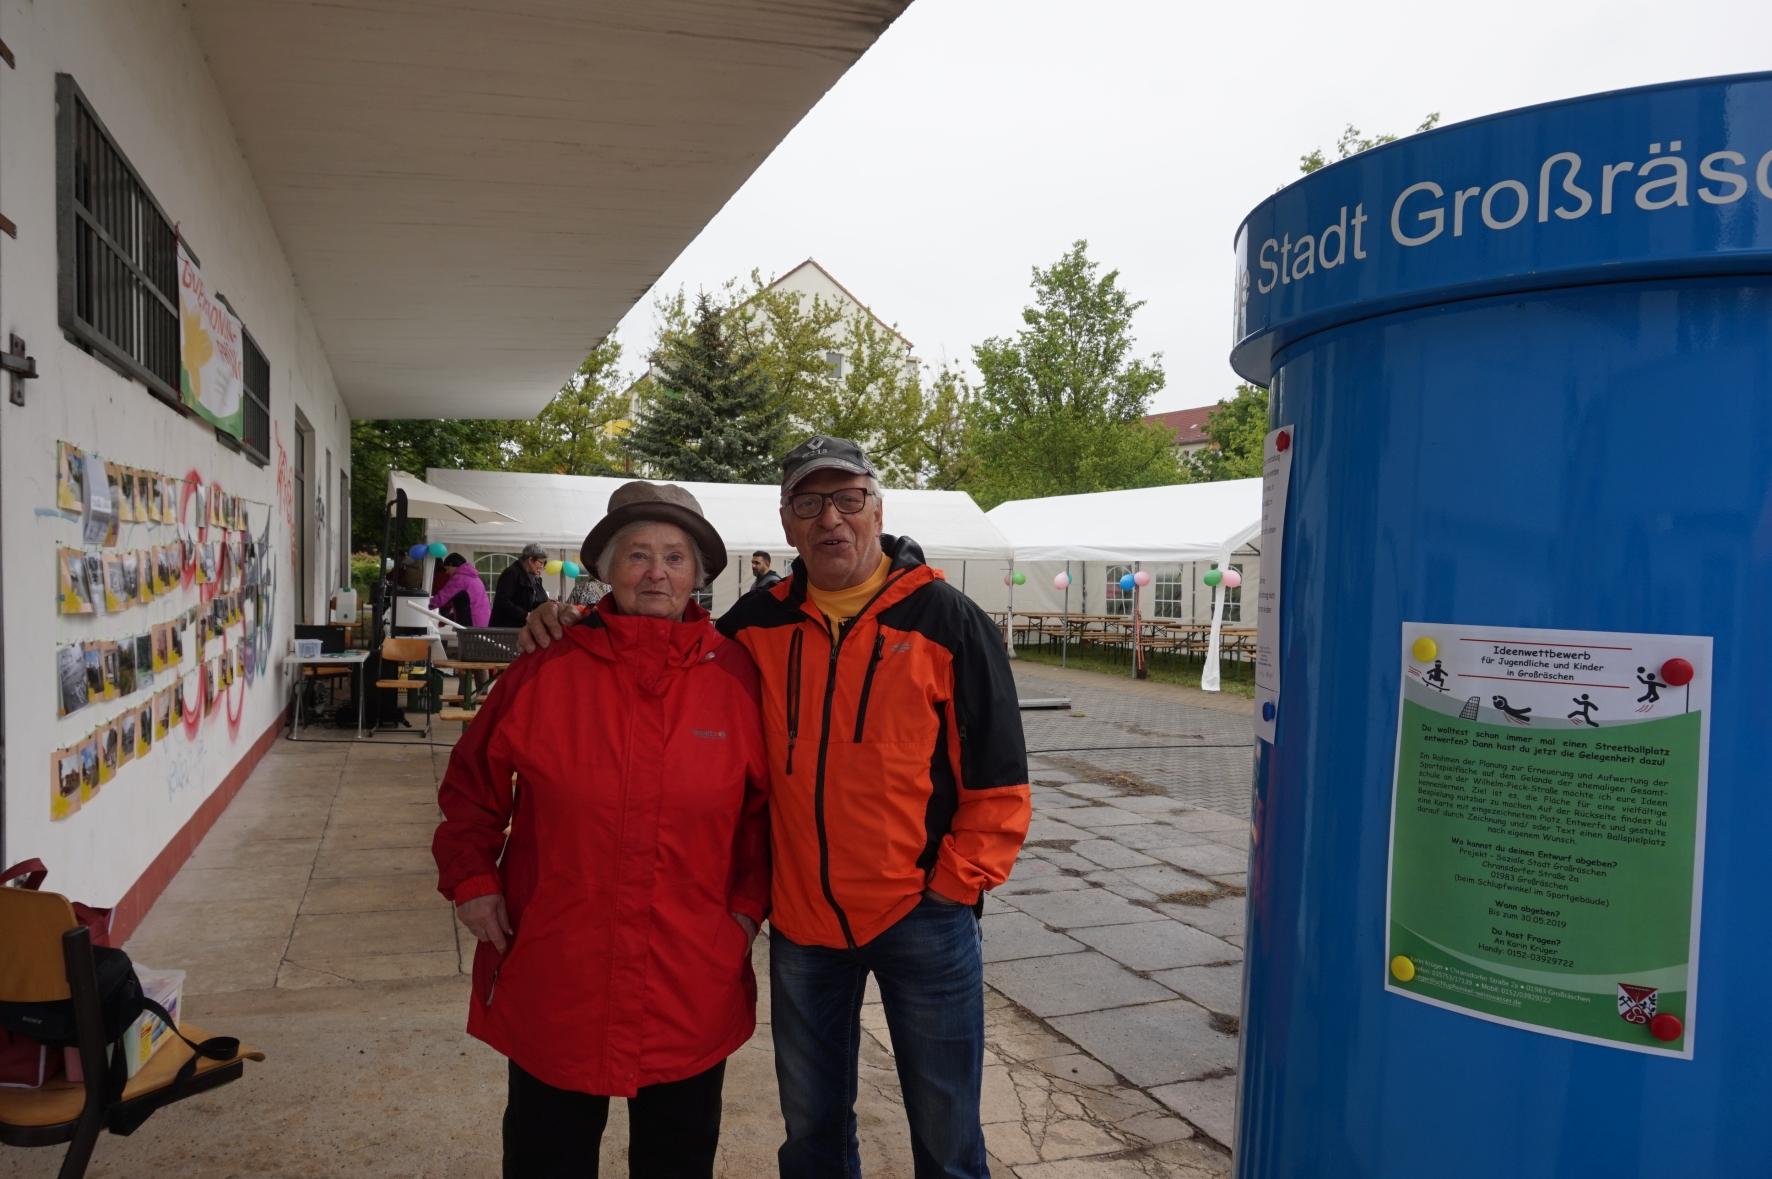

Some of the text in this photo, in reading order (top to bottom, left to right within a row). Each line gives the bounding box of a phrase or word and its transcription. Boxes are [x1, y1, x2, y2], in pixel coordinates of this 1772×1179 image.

[1256, 202, 1368, 294] Stadt
[1481, 656, 1494, 664] für
[1498, 657, 1549, 668] Jugendliche
[1573, 662, 1604, 671] Kinder
[1493, 646, 1590, 660] Ideenwettbewerb
[1518, 670, 1574, 680] Großräschen
[1422, 724, 1432, 732] Du
[1437, 727, 1468, 736] wolltest
[1476, 731, 1499, 739] schon
[1563, 740, 1587, 748] einen
[1596, 742, 1670, 756] Streetballplatz
[1424, 735, 1469, 745] entwerfen?
[1472, 740, 1492, 749] Dann
[1497, 743, 1515, 751] hast
[1534, 746, 1556, 756] jetzt
[1579, 751, 1634, 763] Gelegenheit
[1432, 753, 1459, 764] Rahmen
[1479, 759, 1507, 771] Planung
[1527, 765, 1574, 779] Erneuerung
[1598, 773, 1648, 786] Aufwertung
[1653, 778, 1668, 787] der
[1473, 777, 1558, 794] Wilhelm-Pieck-Straße
[1563, 789, 1594, 799] möchte
[1641, 797, 1668, 806] Ideen
[1577, 781, 1625, 793] ehemaligen
[1631, 786, 1668, 796] Gesamt-
[1457, 794, 1486, 803] nutzbar
[1574, 809, 1616, 821] Rückseite
[1621, 814, 1651, 824] findest
[1472, 786, 1486, 794] Ziel
[1622, 806, 1666, 816] vielfältige
[1417, 806, 1440, 814] darauf
[1443, 810, 1464, 818] durch
[1467, 814, 1506, 826] Zeichnung
[1532, 823, 1551, 831] oder
[1557, 826, 1575, 835] Text
[1580, 830, 1602, 839] einen
[1607, 832, 1666, 846] Ballspielplatz
[1434, 799, 1453, 808] Karte
[1472, 806, 1536, 820] eingezeichnetem
[1566, 818, 1606, 830] Entwerfe
[1629, 827, 1666, 837] gestalte
[1507, 830, 1540, 839] eigenem
[1451, 836, 1618, 868] Wo kannst du deinen Entwurf abgeben?
[1459, 847, 1487, 859] Projekt
[1496, 853, 1524, 864] Soziale
[1528, 858, 1550, 868] Stadt
[1553, 861, 1607, 877] Großräschen
[1491, 871, 1568, 891] 01983 Großräschen
[1538, 869, 1566, 881] Straße
[1569, 874, 1579, 883] 2a
[1488, 908, 1567, 928] Bis zum 30.05.2019
[1495, 900, 1560, 917] Wann abgeben?
[1505, 930, 1523, 939] hast
[1527, 933, 1561, 946] Fragen?
[1507, 940, 1527, 950] Karin
